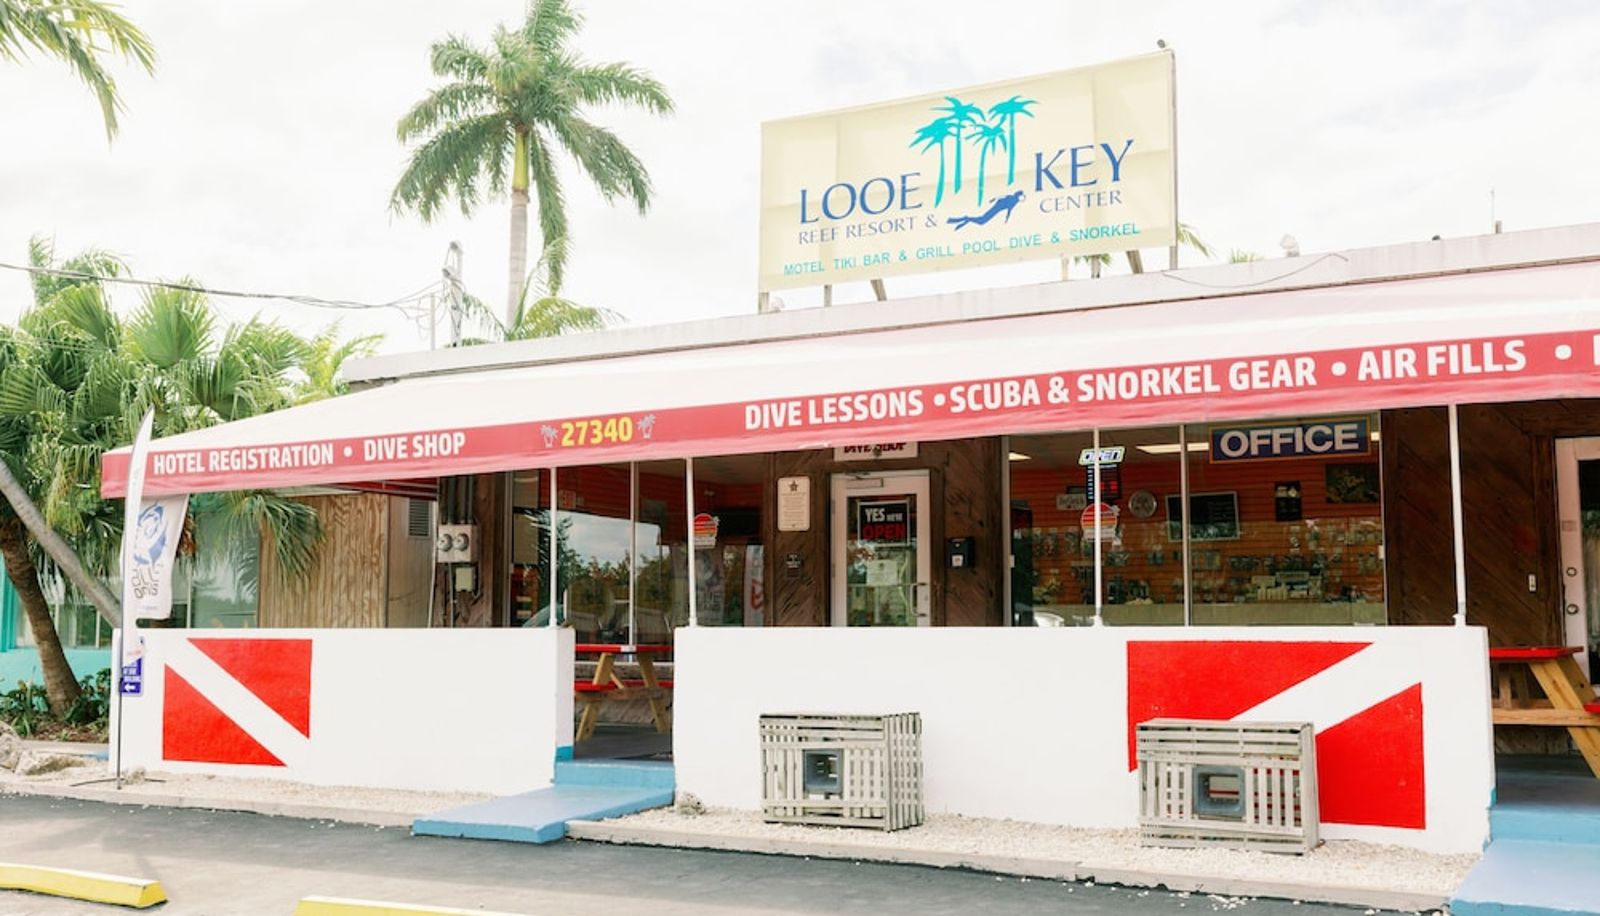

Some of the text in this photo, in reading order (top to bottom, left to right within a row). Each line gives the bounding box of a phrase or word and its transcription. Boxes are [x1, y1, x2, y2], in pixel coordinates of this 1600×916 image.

[800, 139, 1134, 225] LOOE KEY
[799, 189, 1122, 245] REEF RESORT & CENTER
[784, 222, 1140, 276] MOTEL TIKI BAR & GRILL POOL DIVE & SNORKEL
[744, 339, 1527, 431] DIVE LESSONS SCUBA & SNORKEL GEAR AIR FILLS
[153, 431, 466, 476] HOTEL REGISTRATION DIVE SHOP
[560, 416, 633, 447] 27340
[1219, 422, 1360, 458] OFFICE
[863, 523, 906, 541] OPEN
[865, 508, 886, 522] YES
